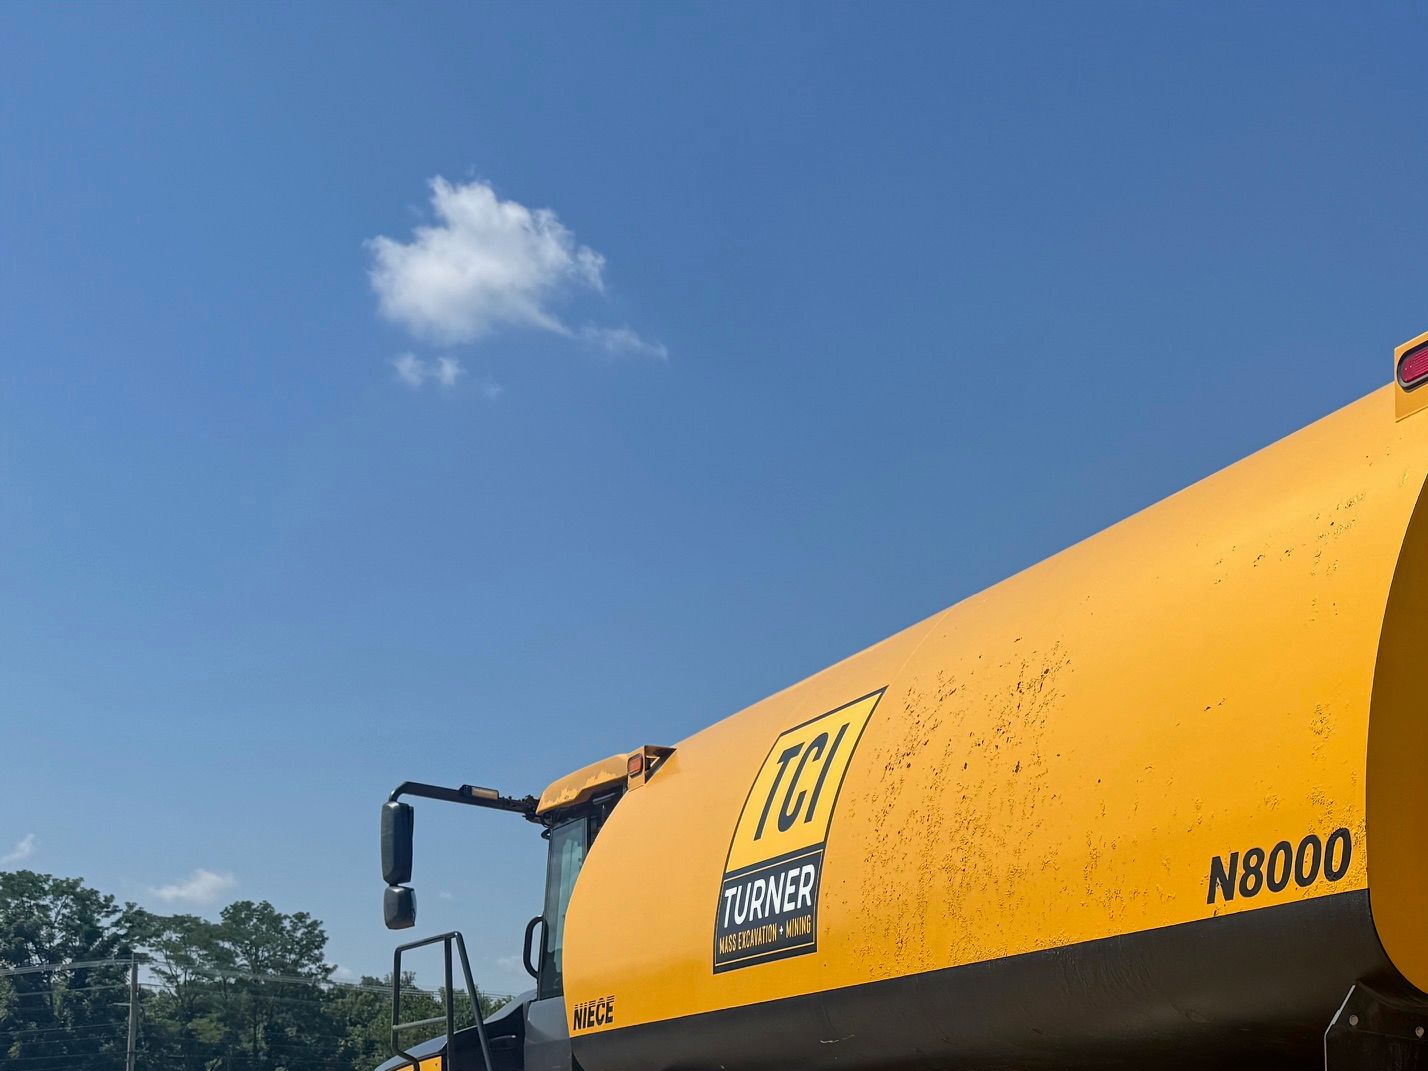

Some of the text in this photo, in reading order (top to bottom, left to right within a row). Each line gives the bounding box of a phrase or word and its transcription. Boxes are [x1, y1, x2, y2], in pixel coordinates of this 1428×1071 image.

[753, 721, 851, 842] TCI
[724, 864, 816, 929] TURNER
[1206, 827, 1352, 905] N8000
[719, 933, 737, 955] MASS
[738, 922, 777, 950] EXCAVATION
[785, 914, 812, 939] MINING
[573, 994, 615, 1031] NIECE
